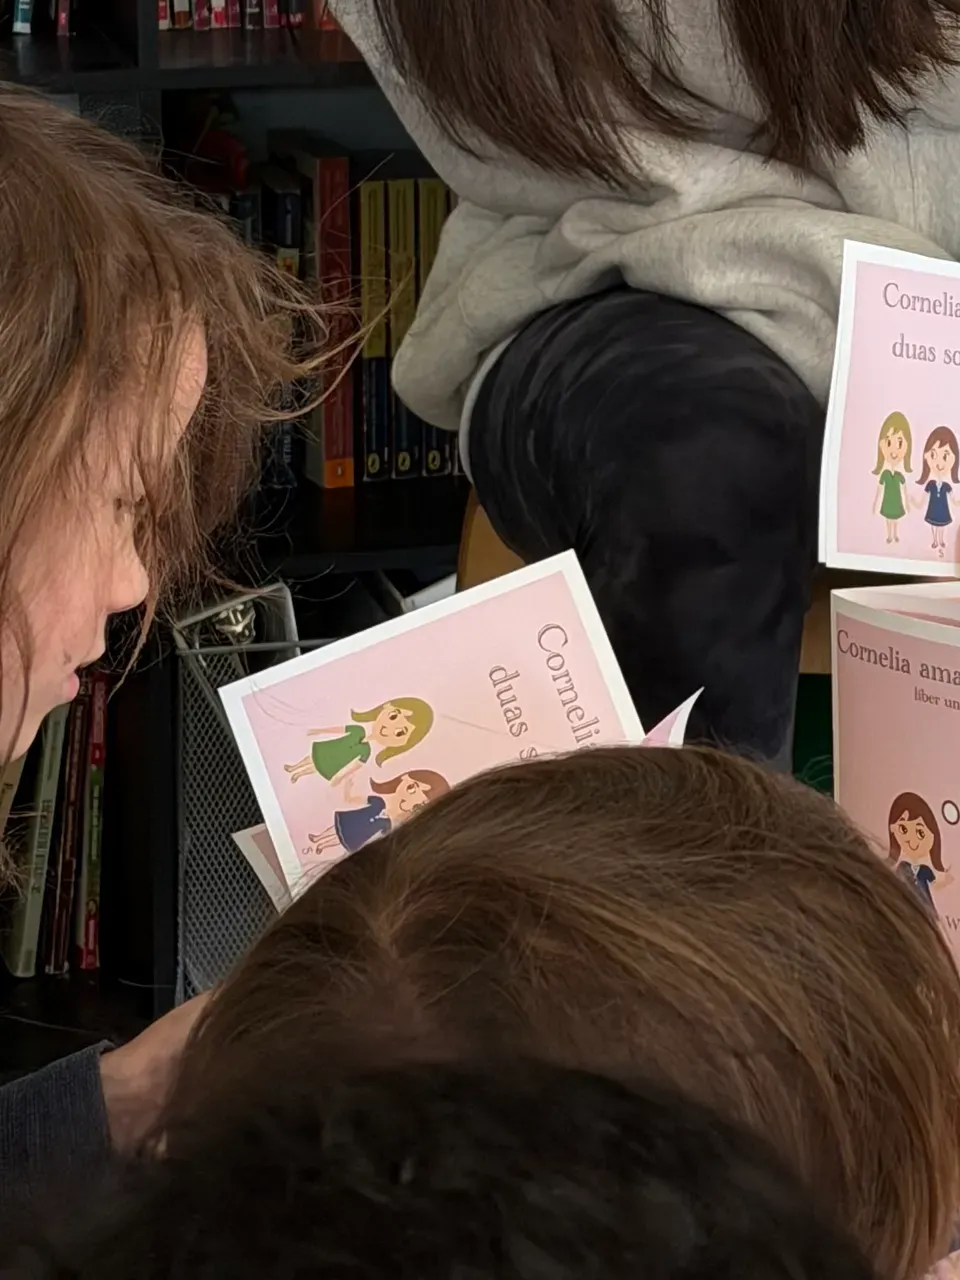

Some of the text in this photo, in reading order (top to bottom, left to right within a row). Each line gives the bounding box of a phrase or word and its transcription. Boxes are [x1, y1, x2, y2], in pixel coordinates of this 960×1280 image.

[892, 332, 937, 363] duas
[837, 628, 912, 677] Cornelia
[488, 665, 529, 738] duas
[914, 686, 940, 707] liber
